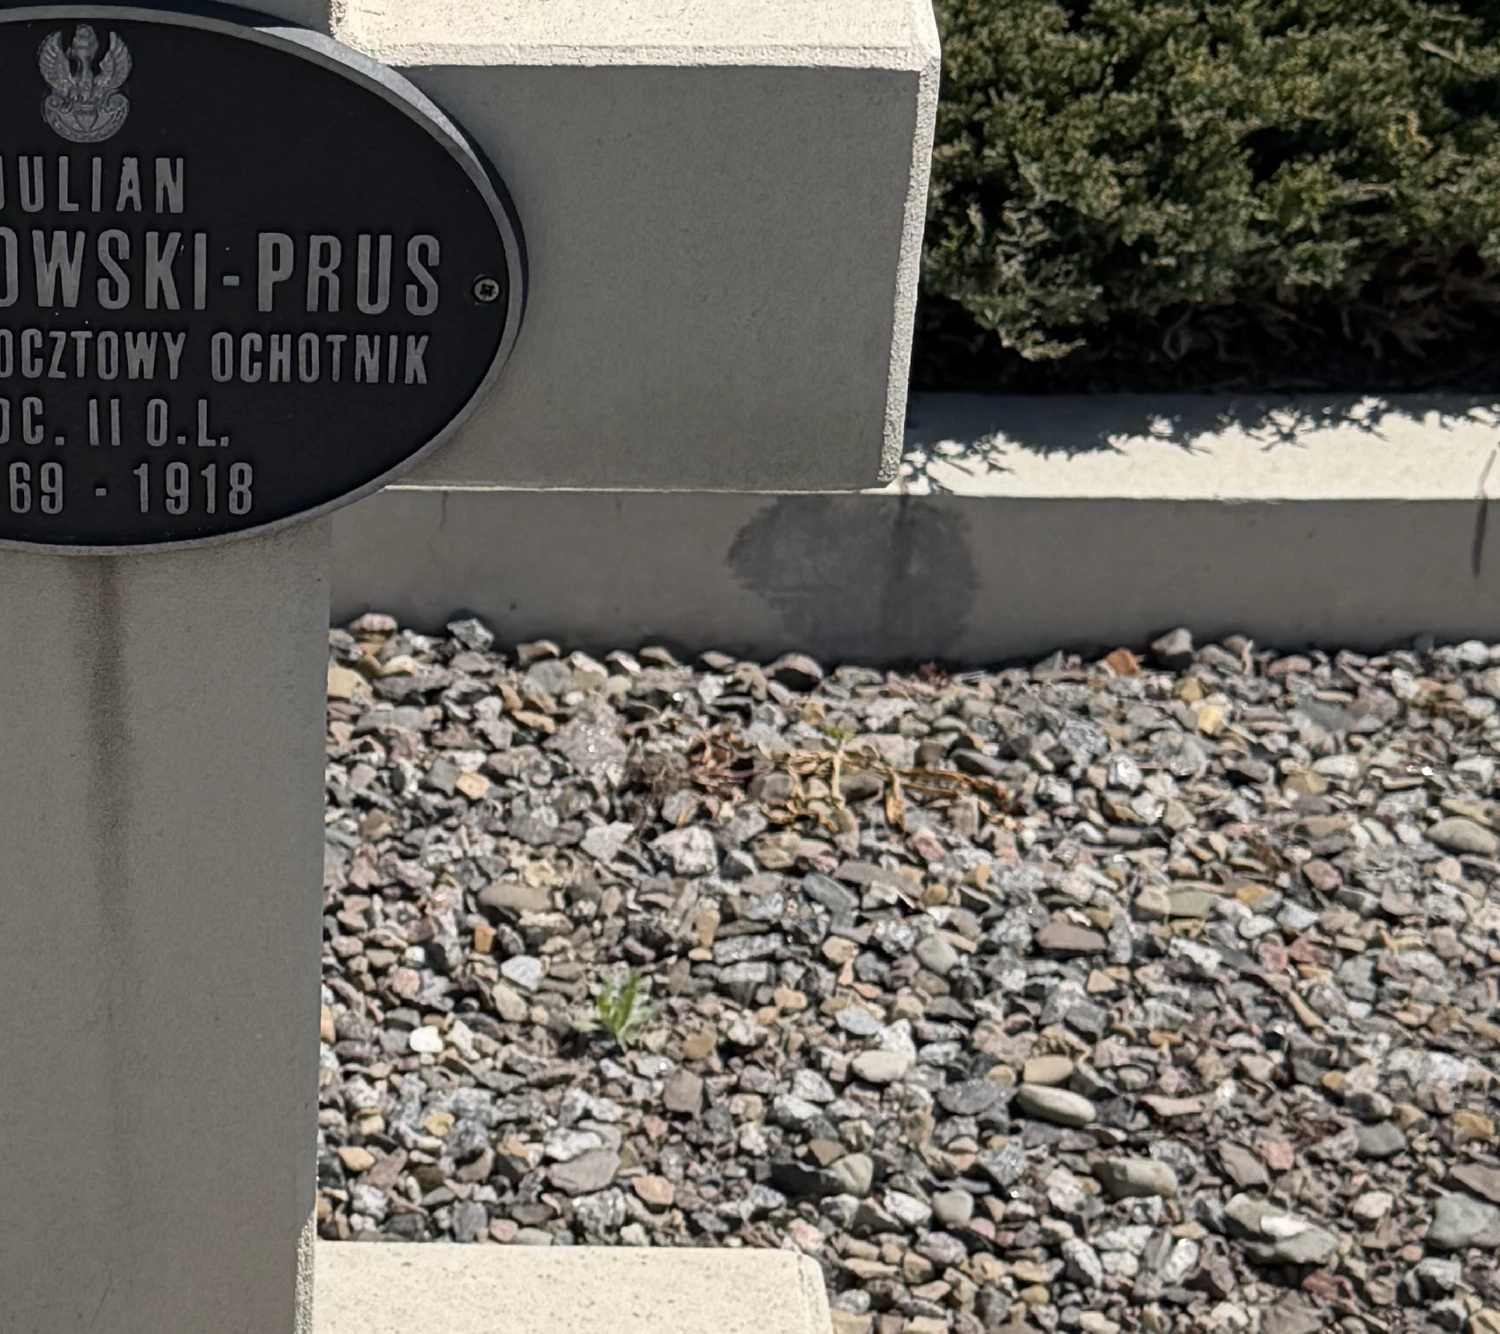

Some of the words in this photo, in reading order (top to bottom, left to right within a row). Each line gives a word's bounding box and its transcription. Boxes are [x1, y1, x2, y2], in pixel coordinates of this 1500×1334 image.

[211, 332, 429, 384] OCHOTNIK
[88, 399, 121, 446] II
[133, 462, 253, 515] 1918
